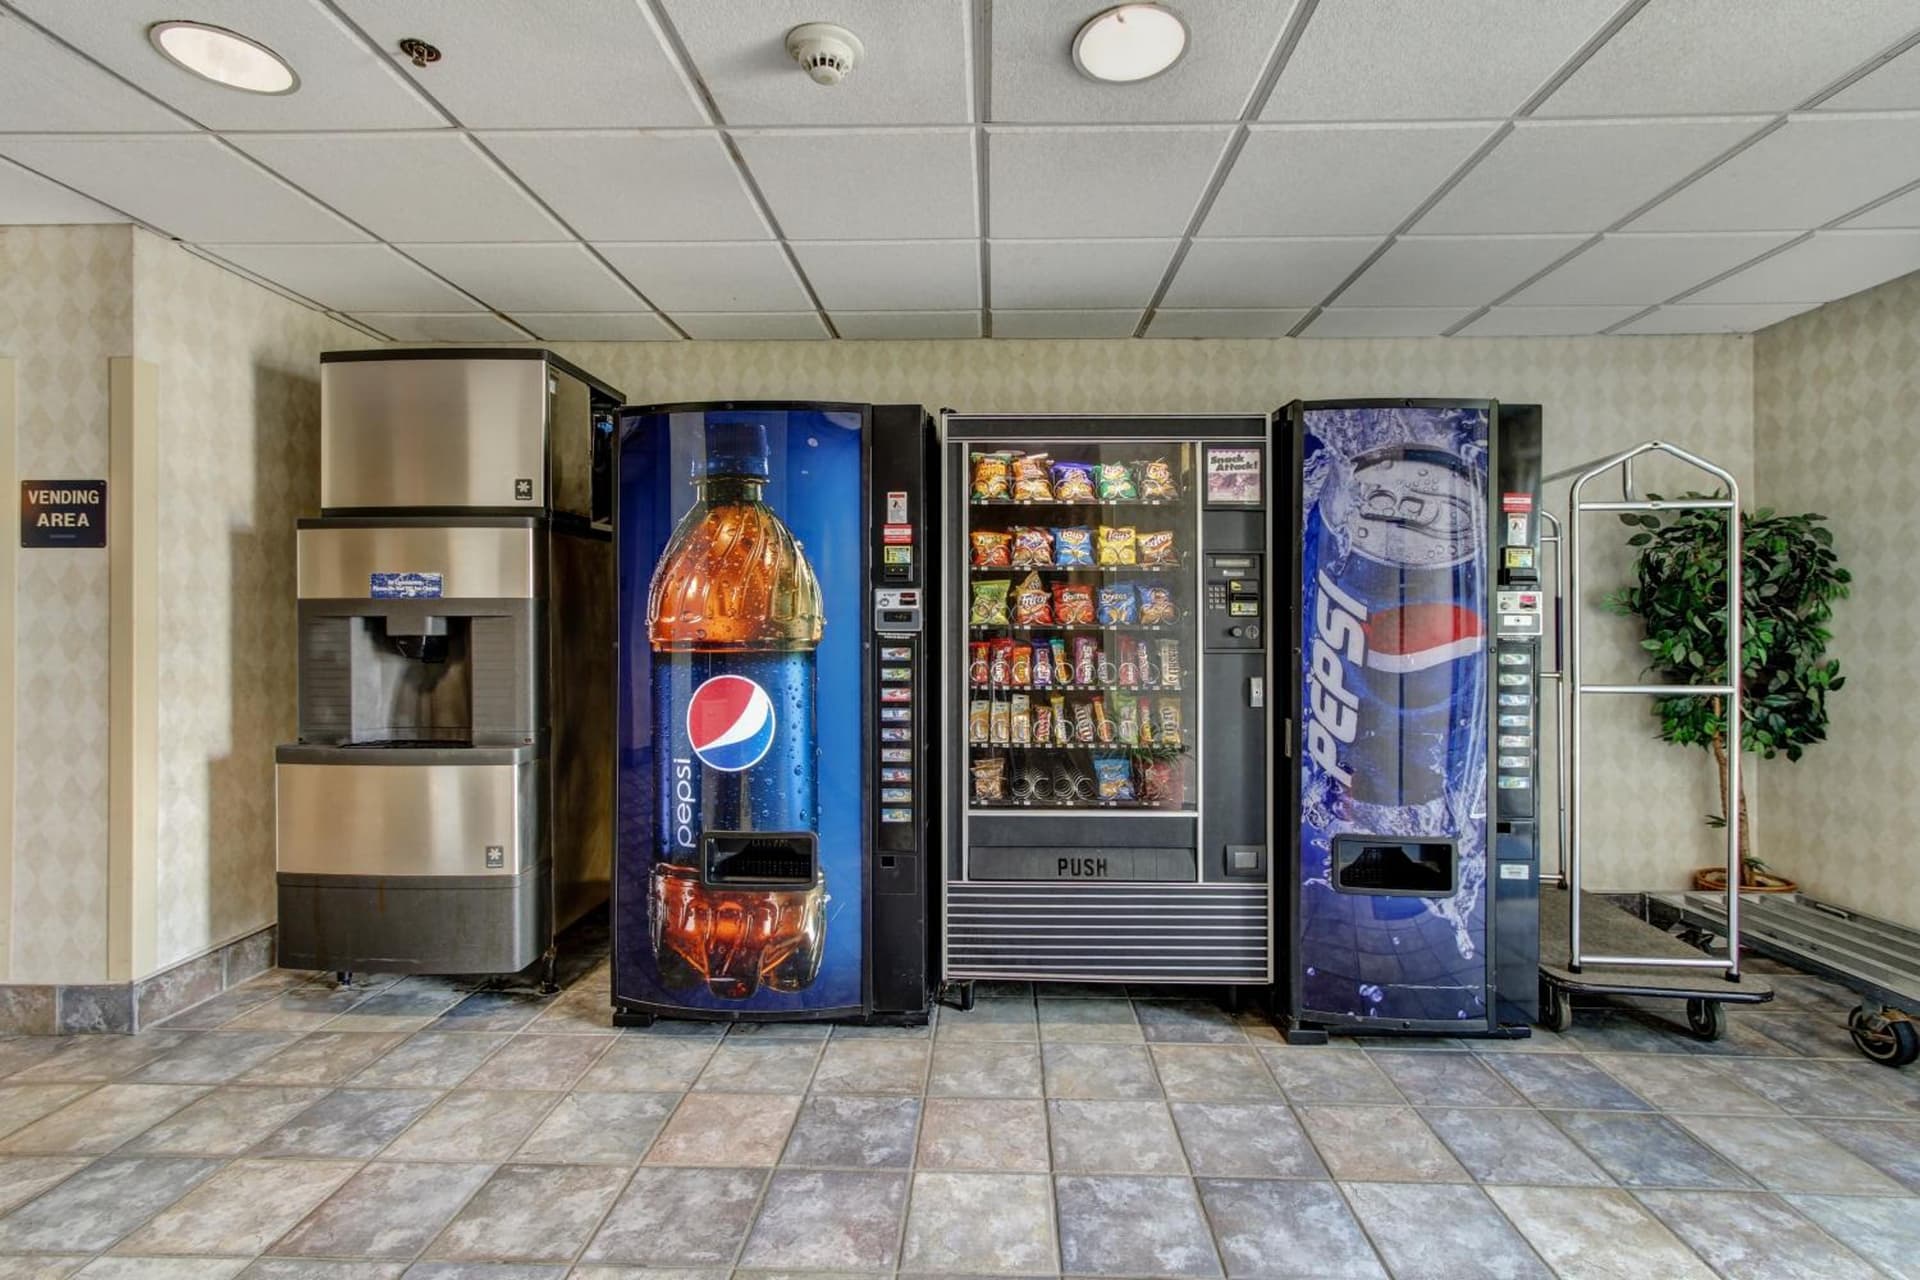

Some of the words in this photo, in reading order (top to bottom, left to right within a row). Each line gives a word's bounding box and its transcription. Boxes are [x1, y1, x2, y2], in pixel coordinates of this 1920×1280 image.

[1210, 454, 1245, 465] Snack
[1215, 460, 1259, 472] Attack!
[27, 489, 100, 505] VENDING
[36, 512, 91, 528] AREA
[1307, 569, 1369, 788] PEPSI
[673, 757, 697, 849] pepsi
[1057, 857, 1109, 878] PUSH
